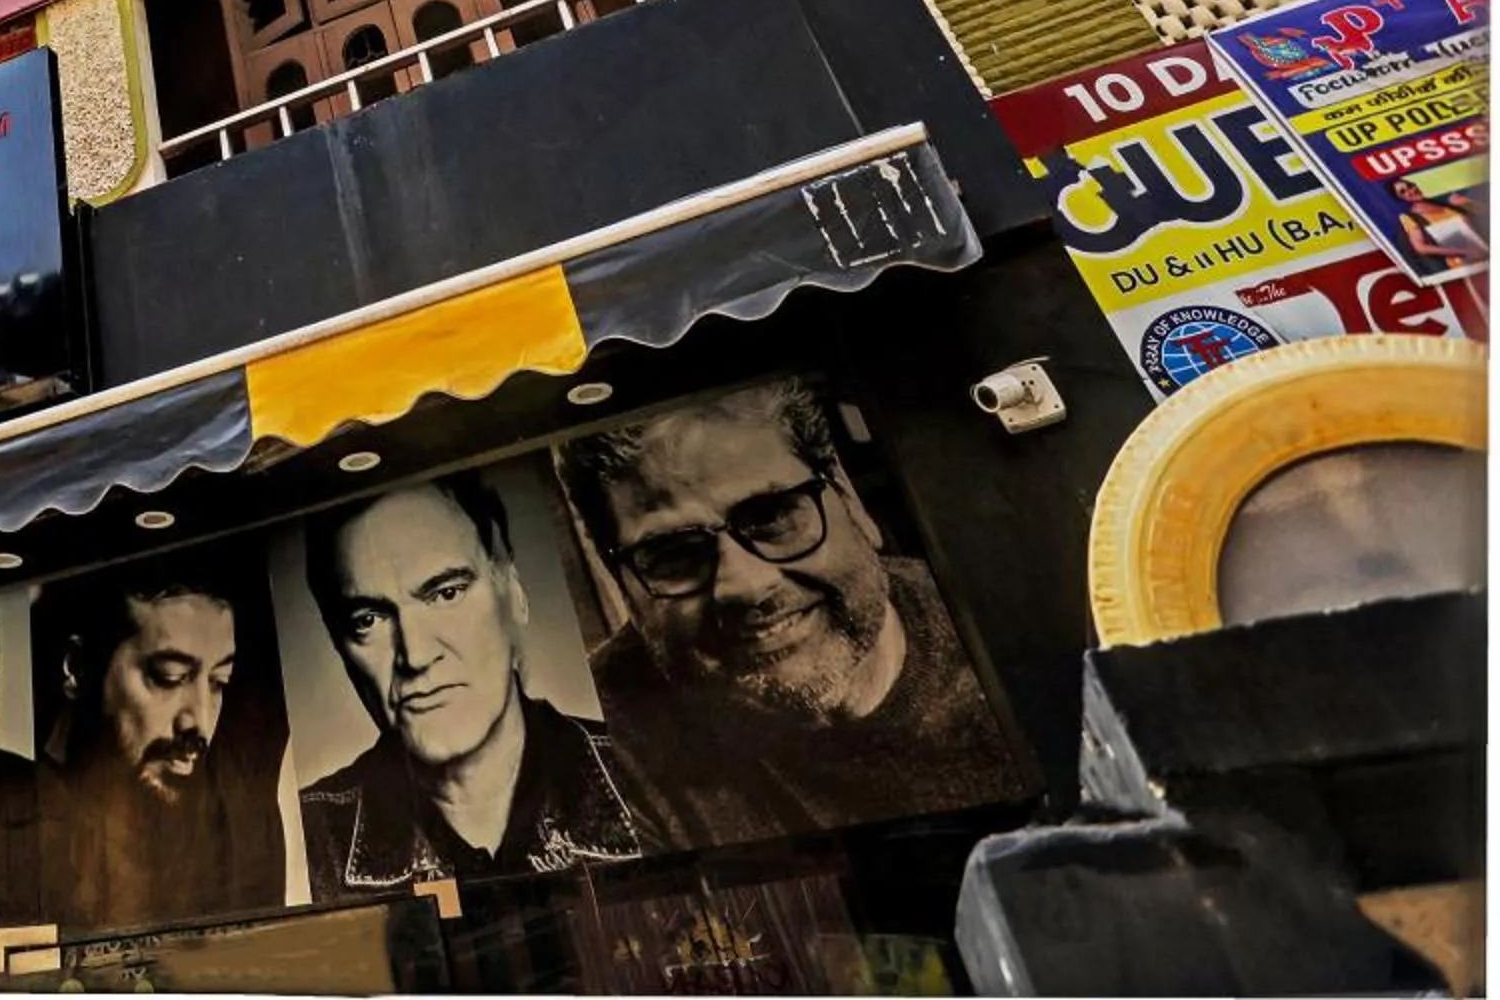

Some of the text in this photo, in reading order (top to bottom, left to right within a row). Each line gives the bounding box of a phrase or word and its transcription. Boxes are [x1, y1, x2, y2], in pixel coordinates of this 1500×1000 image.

[1064, 72, 1146, 123] 10
[1336, 122, 1378, 147] UP
[1111, 262, 1159, 294] DU
[1164, 254, 1194, 278] &
[1153, 318, 1171, 337] OF
[1169, 308, 1269, 346] KNOWLEDGE
